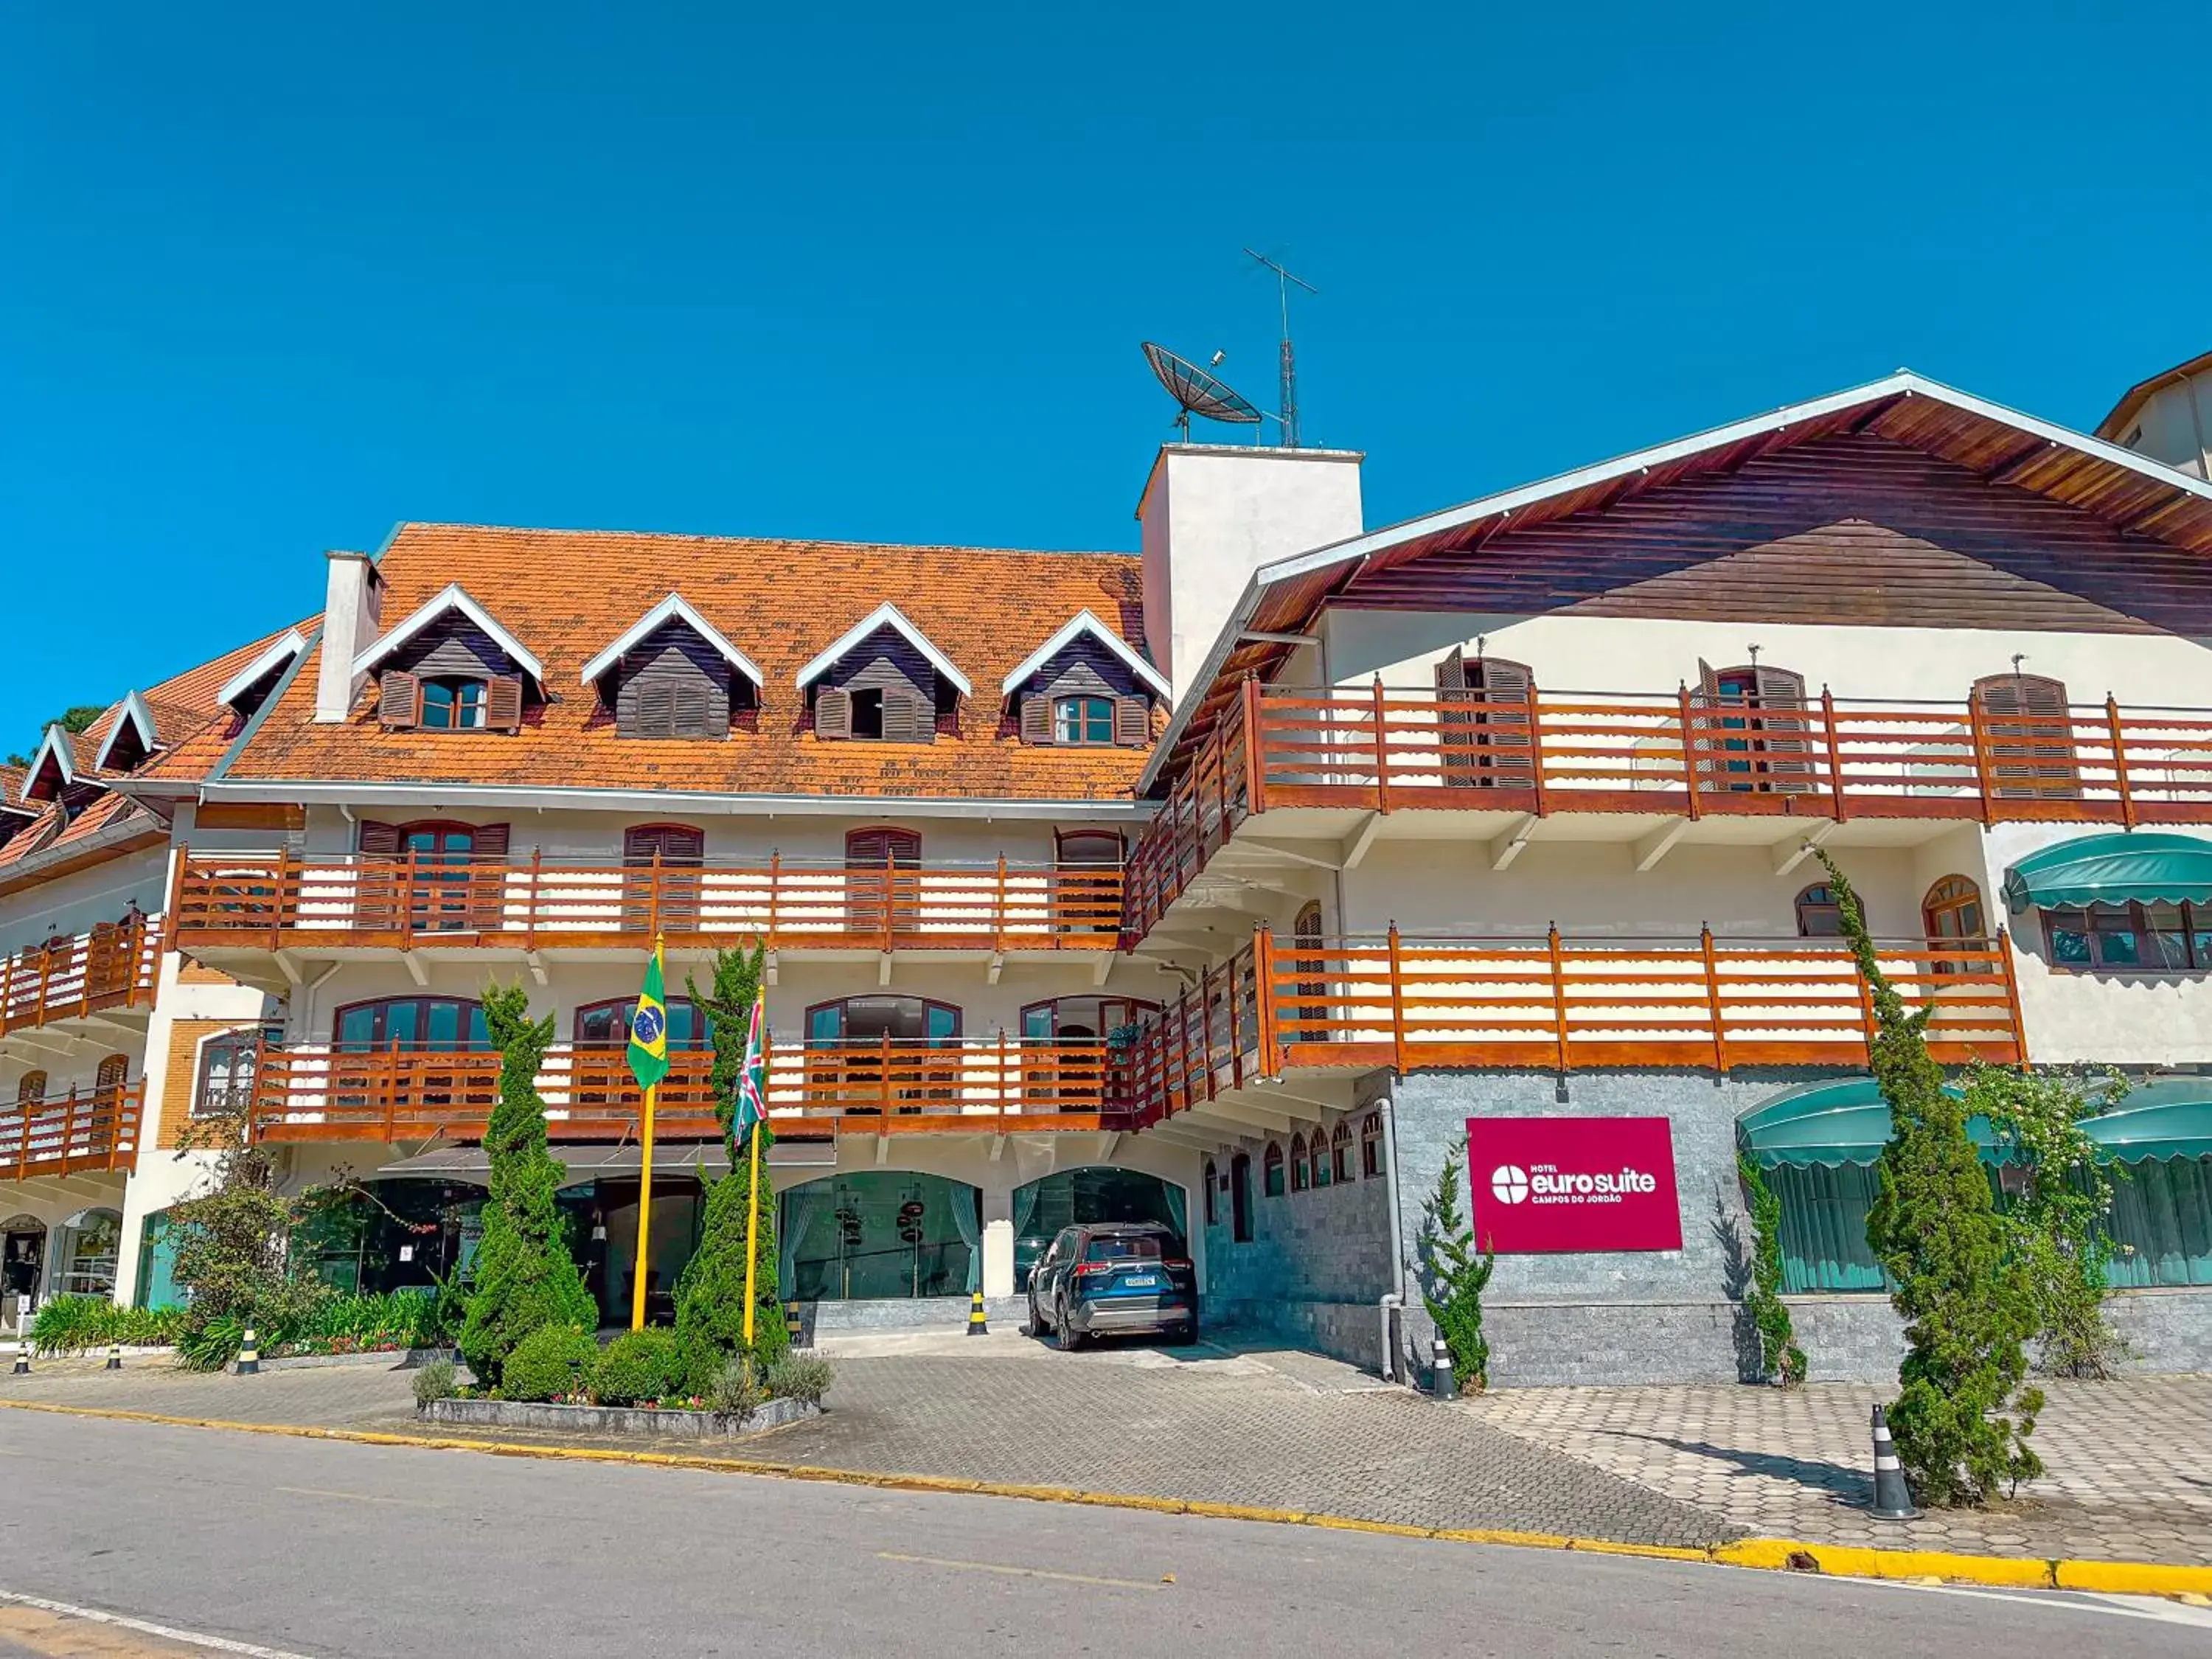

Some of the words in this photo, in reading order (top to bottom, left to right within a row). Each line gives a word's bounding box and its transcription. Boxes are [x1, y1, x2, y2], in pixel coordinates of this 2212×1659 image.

[1530, 1164, 1557, 1173] HOTEL
[1531, 1167, 1656, 1194] eurosuite
[1531, 1195, 1570, 1204] CAMPOS
[1571, 1195, 1585, 1203] DO
[1586, 1193, 1622, 1203] JORDÃO
